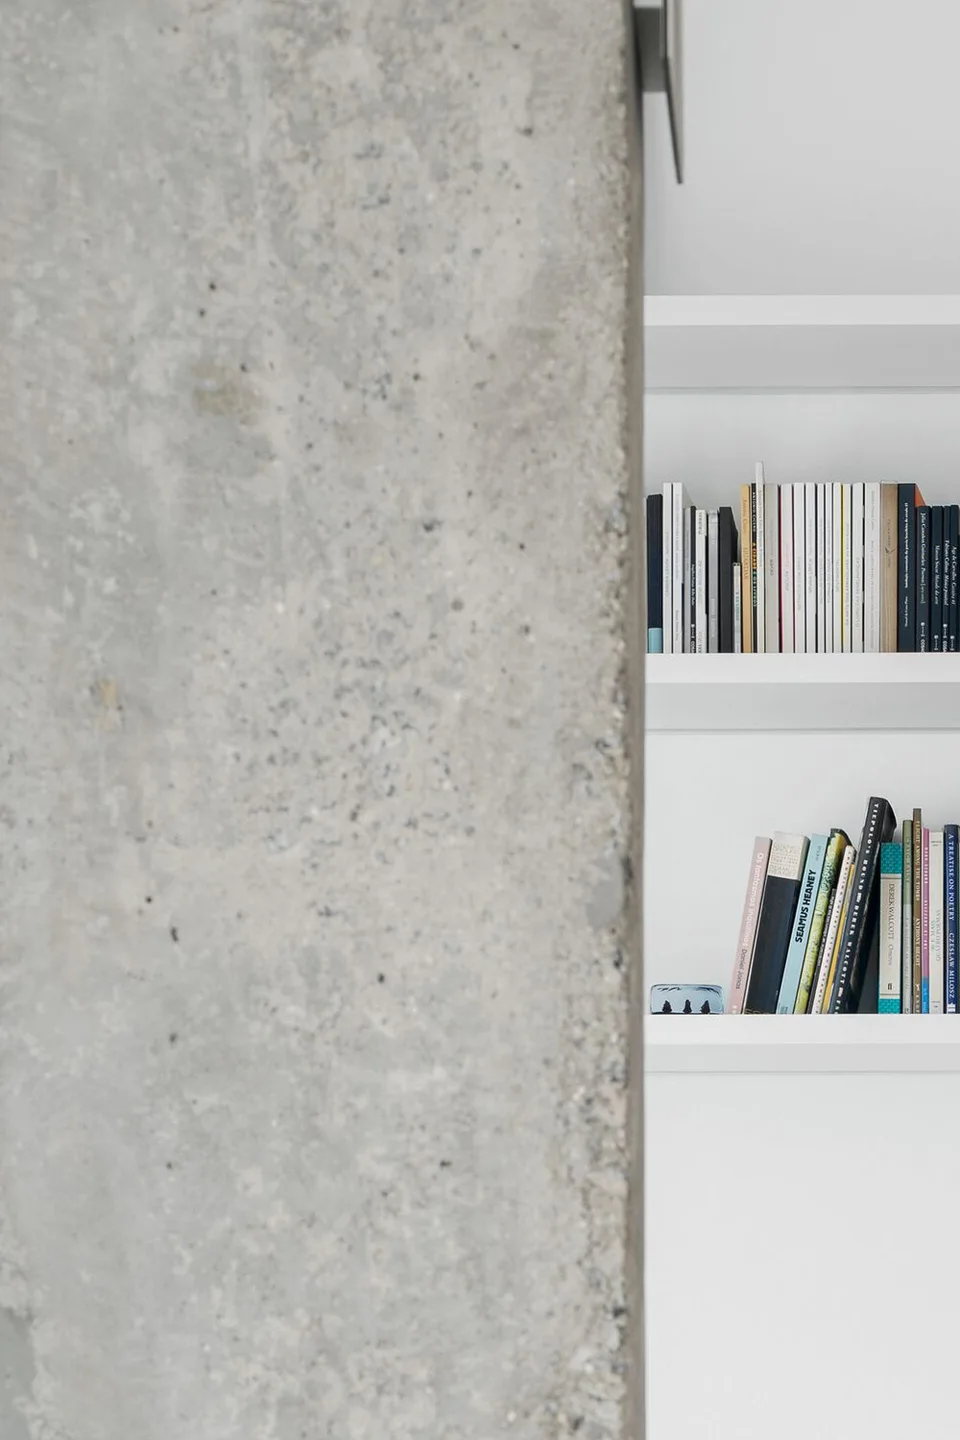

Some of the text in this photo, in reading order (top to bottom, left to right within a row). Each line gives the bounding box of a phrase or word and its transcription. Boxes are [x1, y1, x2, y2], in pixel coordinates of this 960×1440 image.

[865, 803, 879, 854] TIEPOLO'S
[858, 860, 868, 890] HOUND
[949, 879, 955, 890] ON
[735, 853, 764, 990] Os fantasmas inquilinos Daniel Jonas
[796, 870, 816, 943] SEAMUS HEANEY
[849, 905, 859, 936] DEREK
[840, 941, 852, 984] WALCOTT
